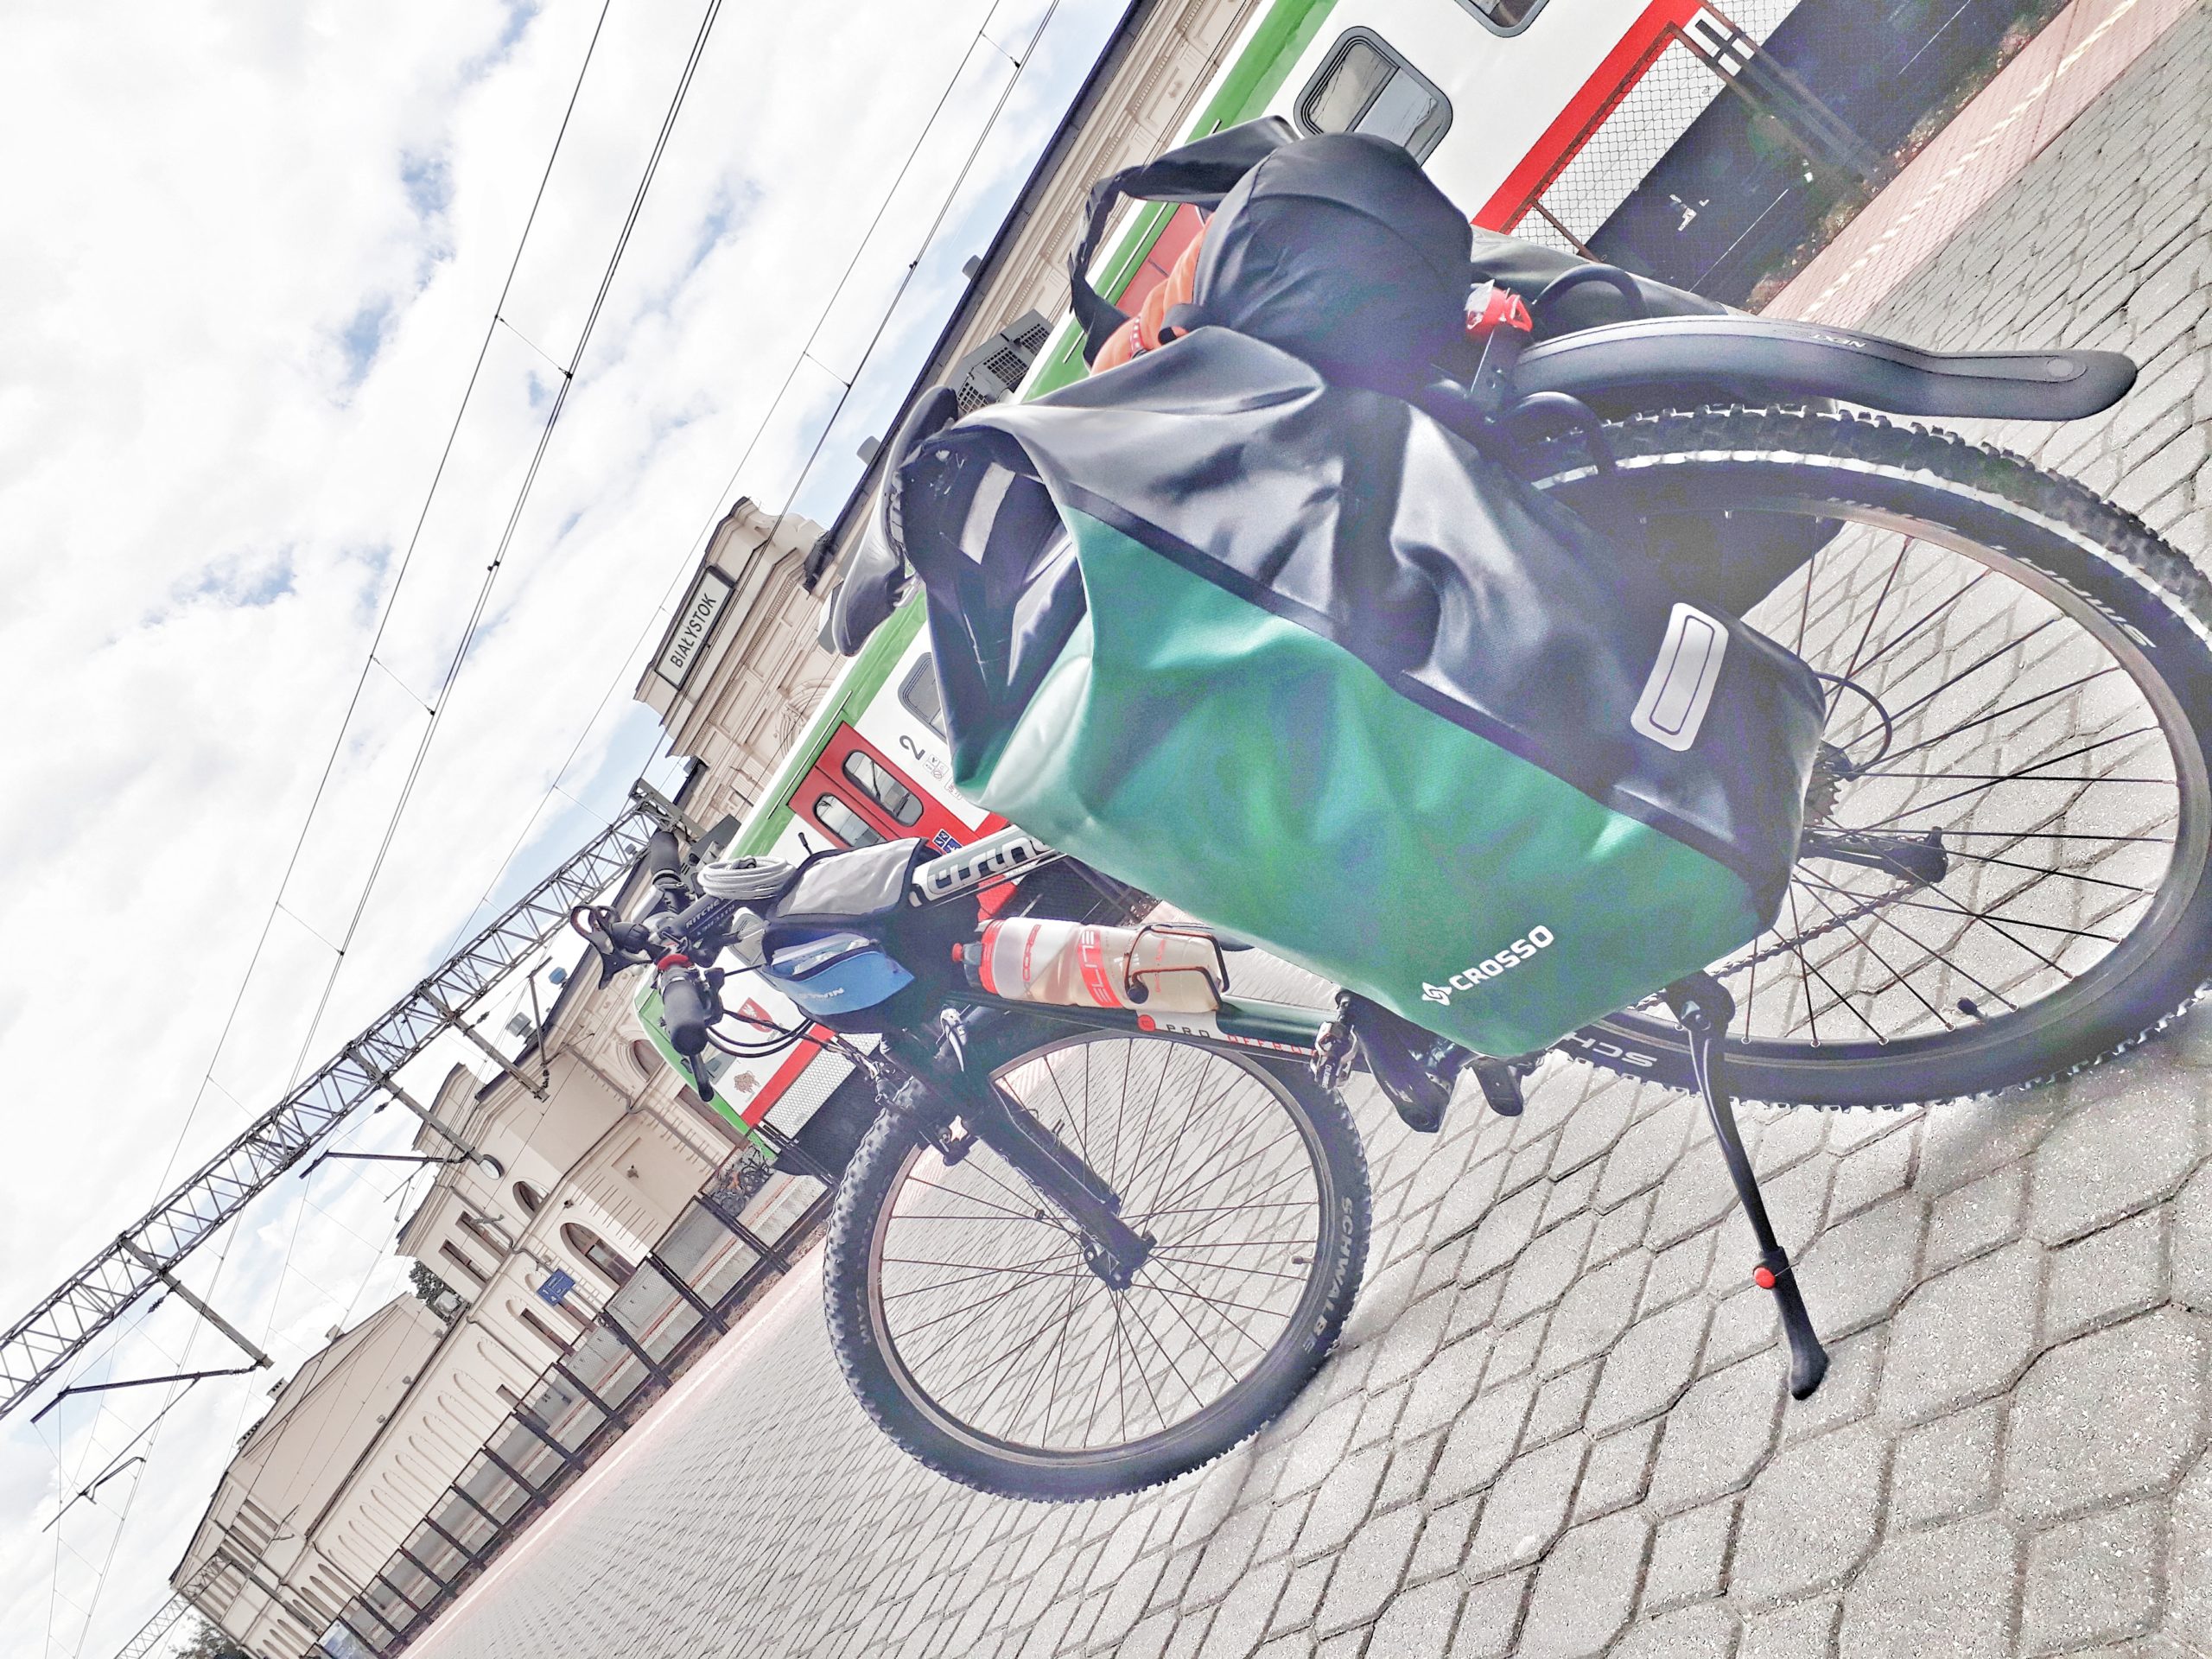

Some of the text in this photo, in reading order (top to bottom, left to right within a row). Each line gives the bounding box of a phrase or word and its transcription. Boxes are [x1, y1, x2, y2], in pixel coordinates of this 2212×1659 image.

[670, 593, 716, 669] BIAŁYSTOK
[899, 734, 925, 760] 2
[685, 899, 724, 927] RITCHE
[1081, 931, 1112, 1004] ELITE
[1449, 925, 1554, 991] CROSSO
[1166, 1023, 1211, 1038] PRO
[1302, 1197, 1353, 1355] SCHWALBE
